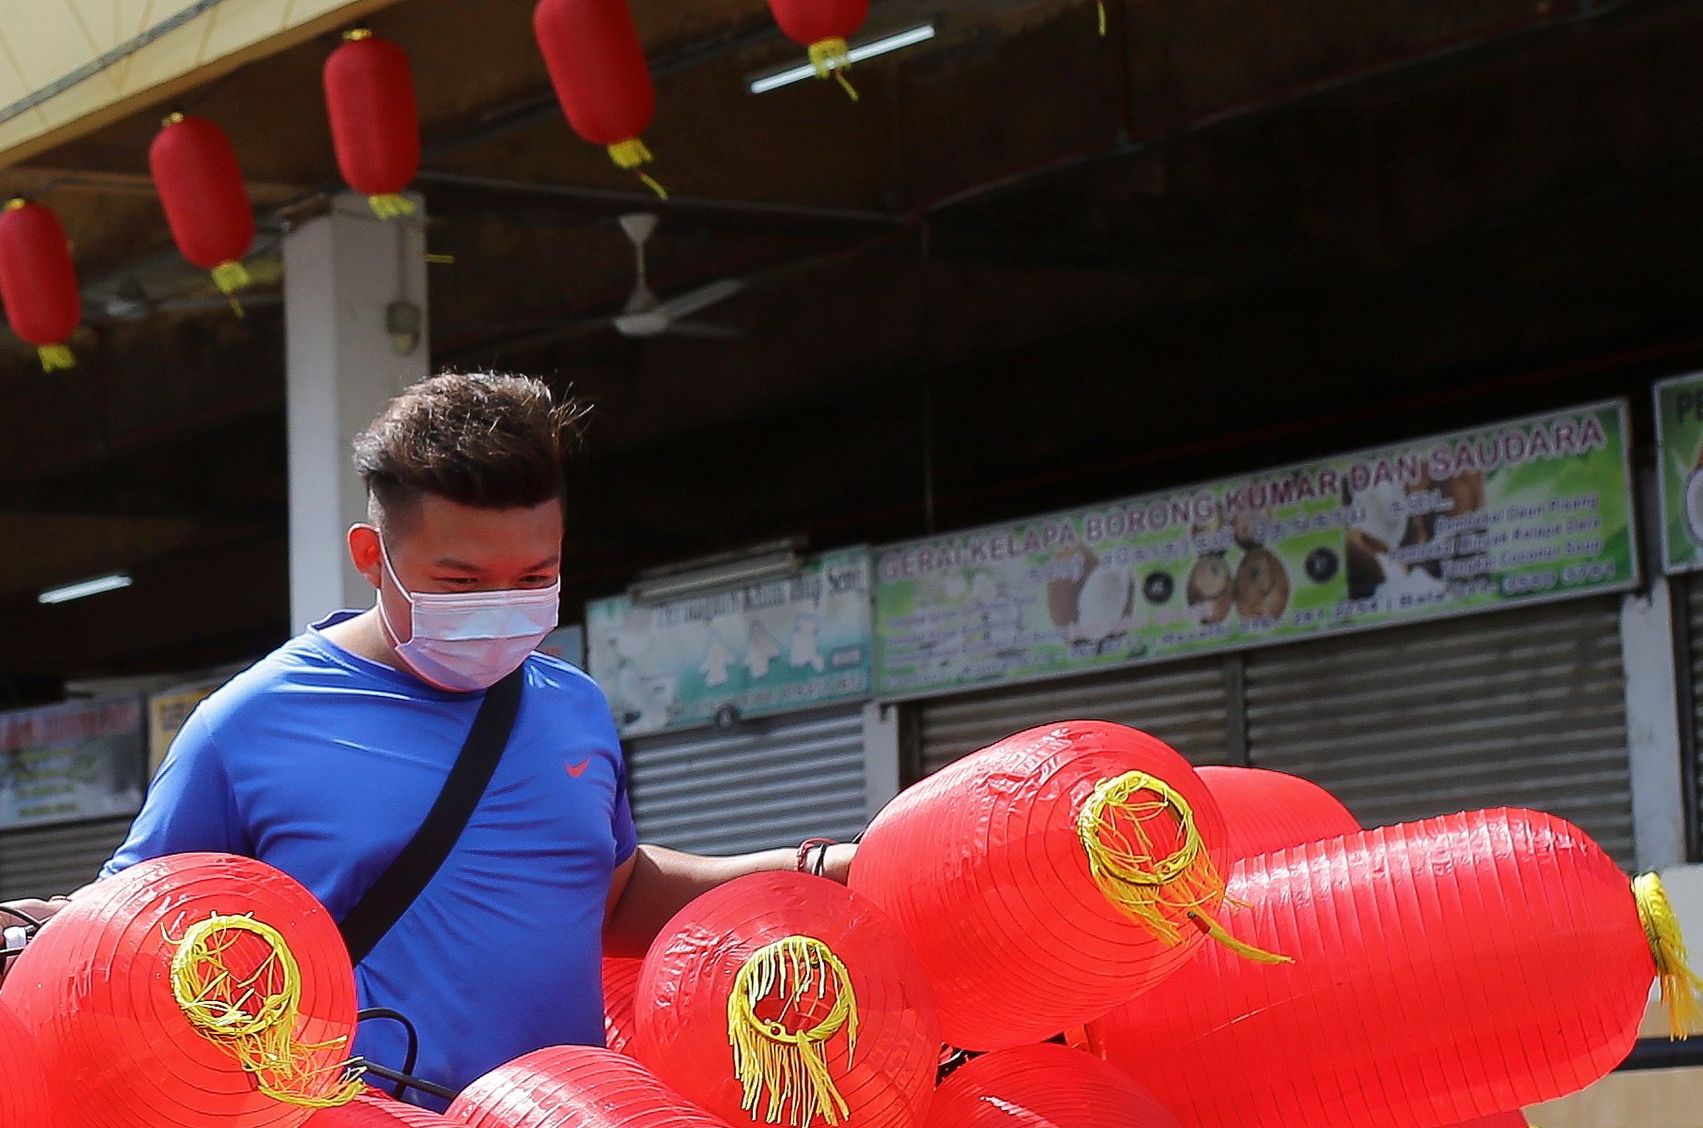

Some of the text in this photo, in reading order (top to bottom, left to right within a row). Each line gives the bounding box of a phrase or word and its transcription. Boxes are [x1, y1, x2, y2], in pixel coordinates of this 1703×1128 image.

[883, 545, 965, 578] GERAI
[970, 523, 1078, 562] KELAPA
[1085, 499, 1215, 541] BORONG
[1225, 469, 1338, 513] KUMAR
[1351, 454, 1420, 492] DAN
[1430, 419, 1604, 475] SAUDARA
